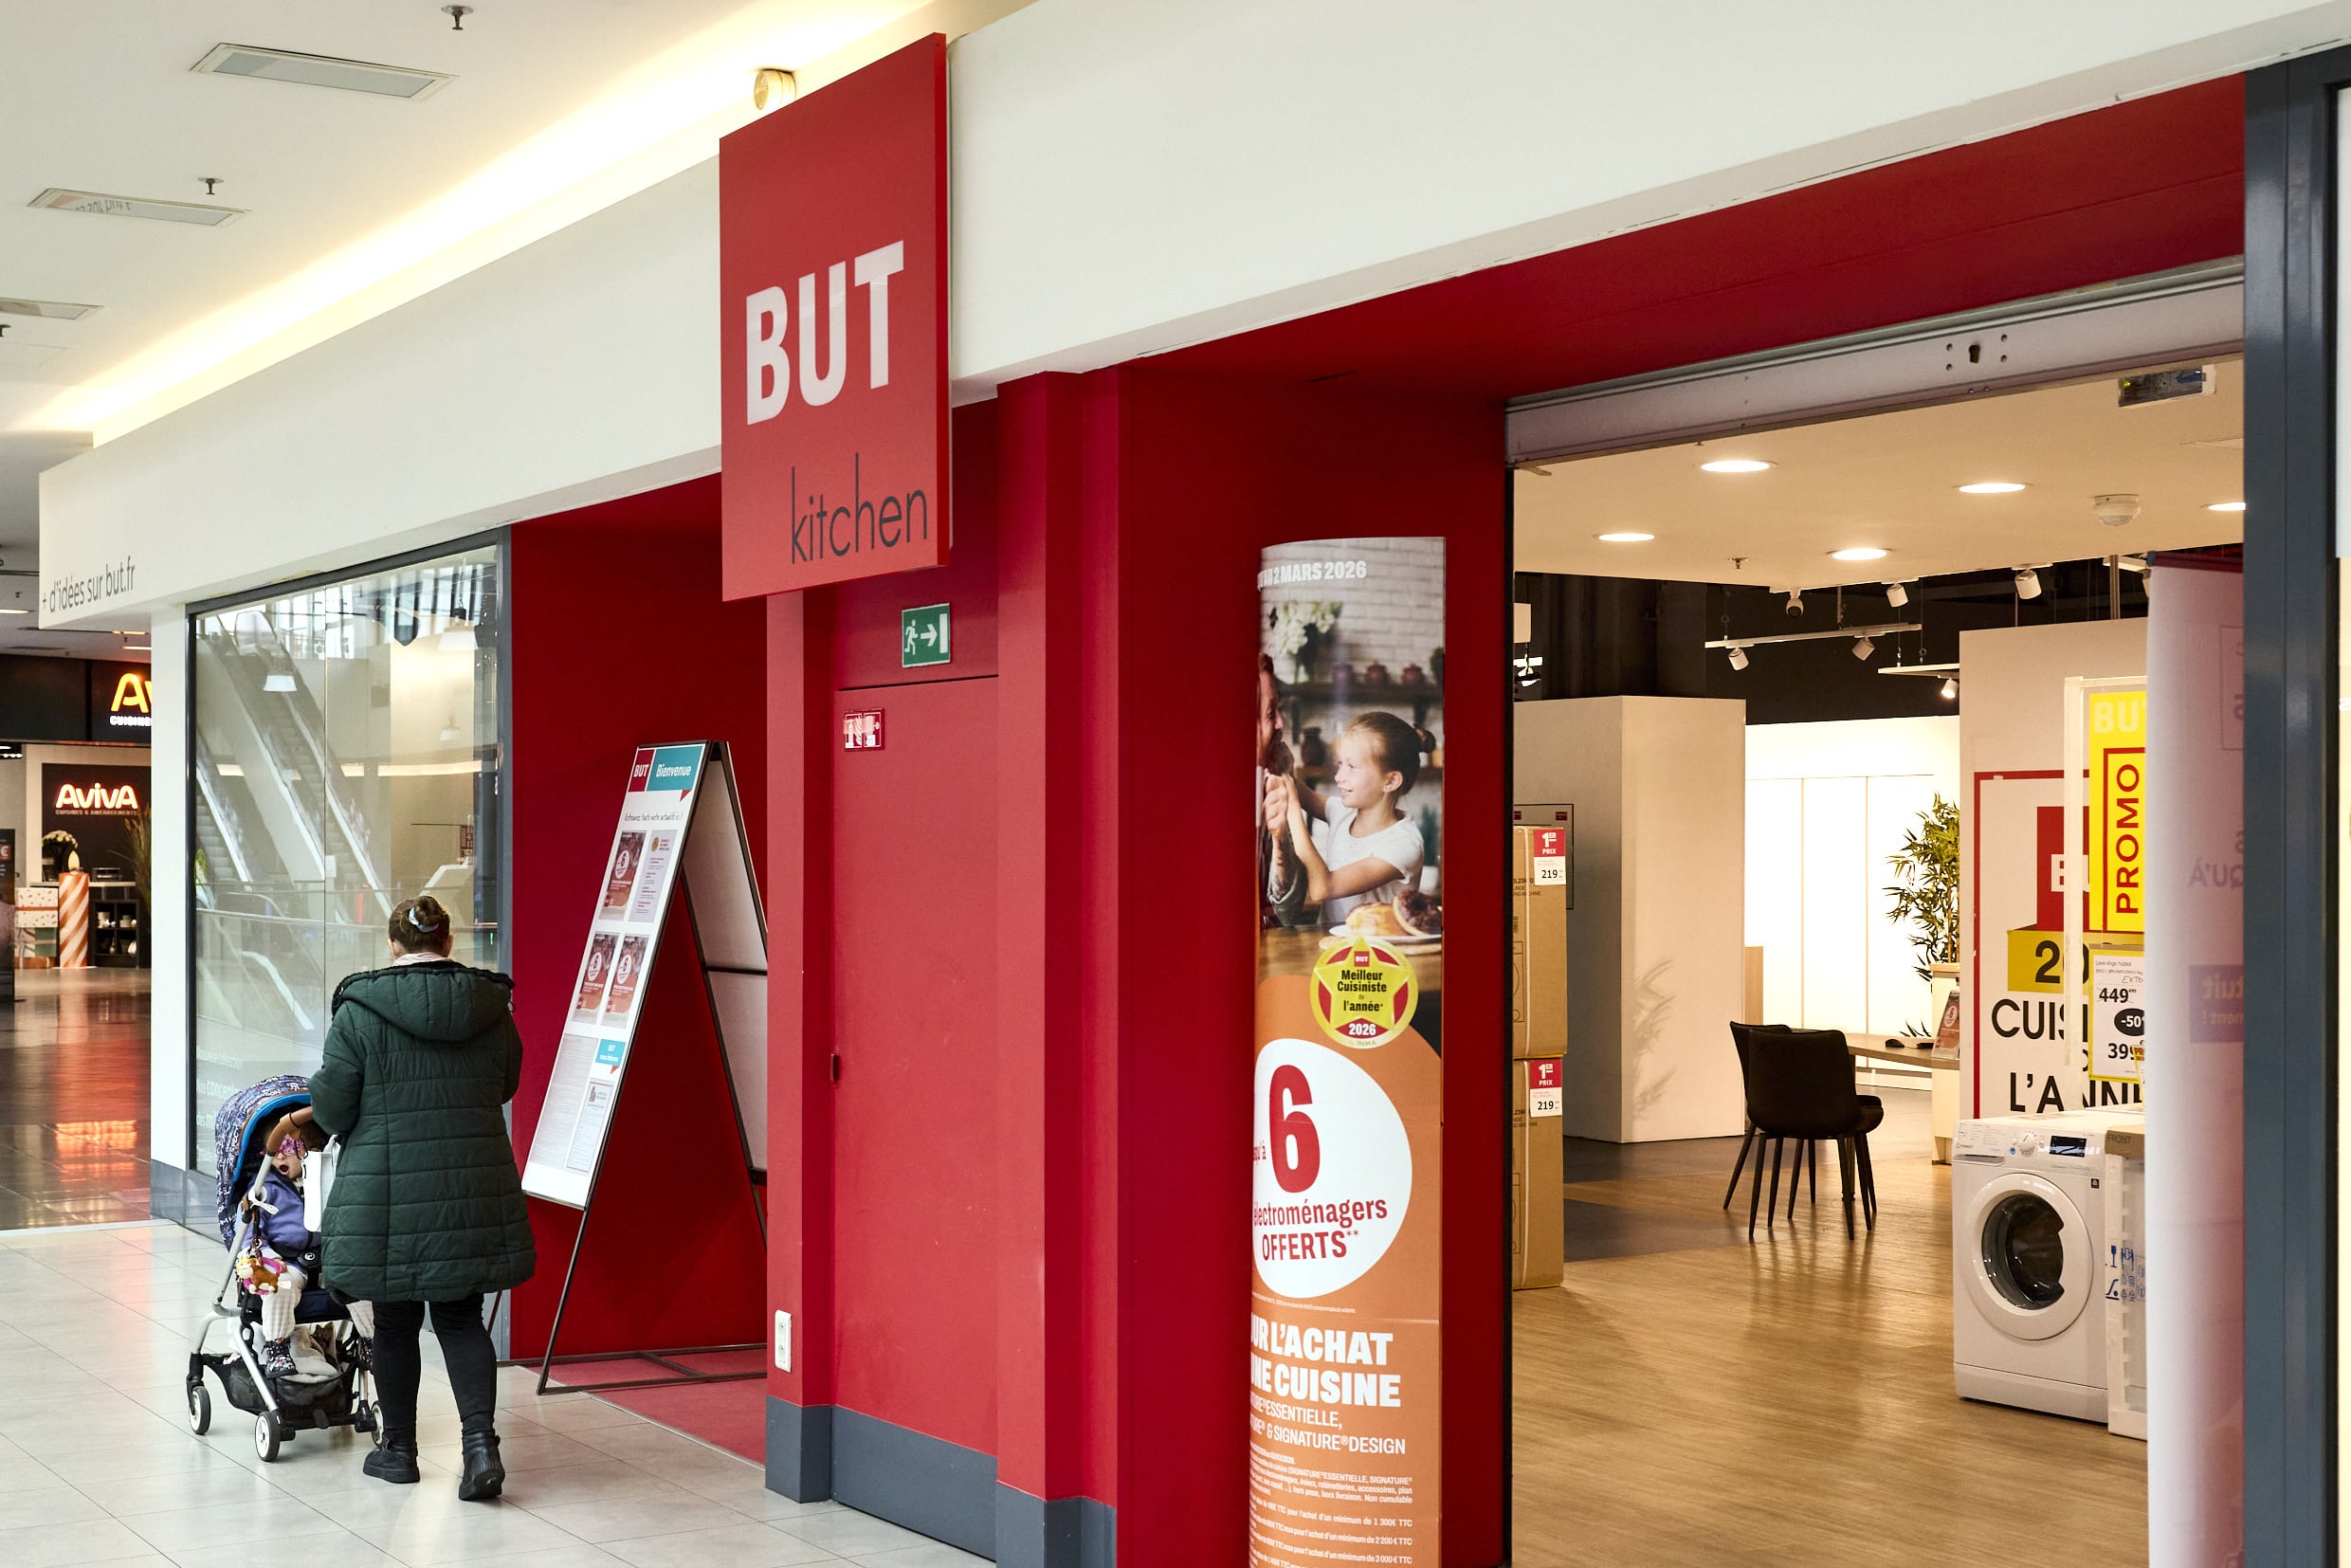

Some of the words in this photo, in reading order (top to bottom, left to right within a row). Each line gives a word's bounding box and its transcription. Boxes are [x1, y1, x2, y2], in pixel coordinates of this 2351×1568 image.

[747, 240, 903, 425] BUT
[791, 452, 927, 564] kitchen
[1273, 567, 1280, 585] 2
[1281, 562, 1321, 583] MARS
[1324, 560, 1367, 579] 2026
[49, 574, 84, 613] d'idées
[87, 574, 103, 603] sur
[106, 556, 136, 597] but.fr
[633, 764, 649, 777] BUT
[656, 763, 692, 777] Bienvenue
[2115, 762, 2141, 915] PROMO
[1541, 869, 1558, 879] 219
[1341, 969, 1383, 980] Meilleur
[1337, 981, 1388, 993] Cuisiniste
[2099, 988, 2129, 1003] 449
[1349, 1023, 1376, 1036] 2026
[1538, 1100, 1555, 1110] 219
[1268, 1064, 1321, 1194] 6
[1270, 1321, 1394, 1366] L'ACHAT
[1274, 1363, 1402, 1408] CUISINE
[1267, 1423, 1273, 1439] &
[1365, 1493, 1377, 1502] Non
[1363, 1517, 1372, 1525] de
[1398, 1519, 1412, 1527] TTC
[1366, 1536, 1375, 1544] de
[1398, 1538, 1412, 1546] TTC
